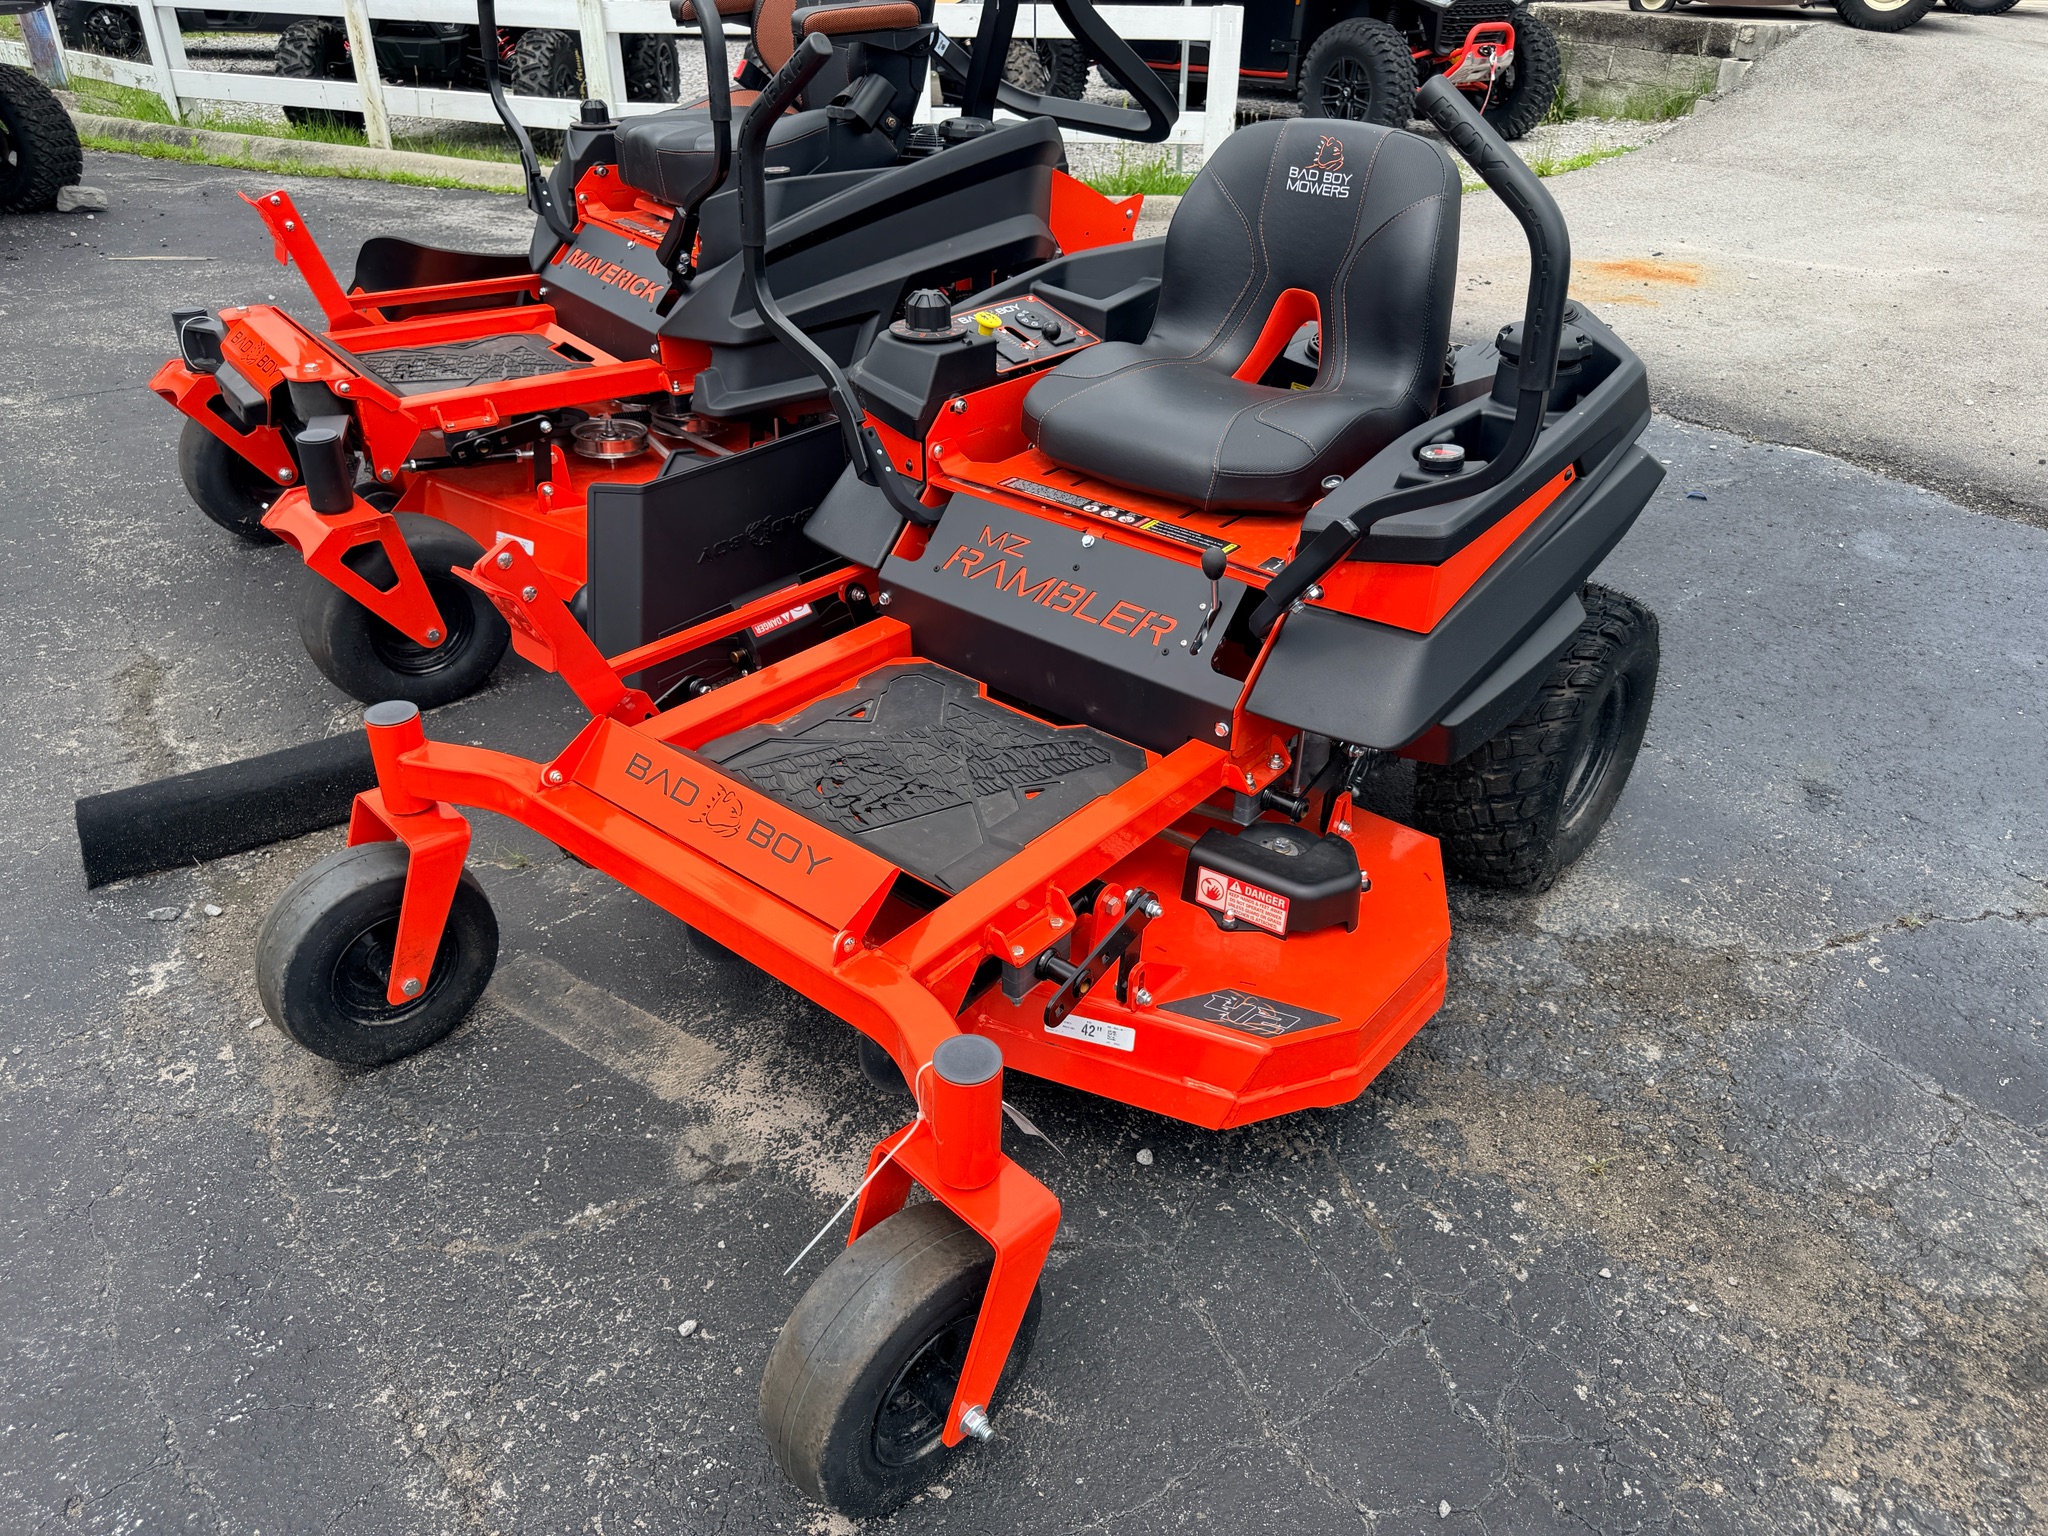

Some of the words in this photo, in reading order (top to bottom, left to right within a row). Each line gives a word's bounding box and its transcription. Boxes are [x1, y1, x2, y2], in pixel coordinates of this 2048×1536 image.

[1426, 95, 1510, 174] BOY
[1286, 177, 1351, 198] MOWERS
[1288, 166, 1319, 181] BAD
[1322, 171, 1353, 186] BOY
[565, 248, 665, 303] MAVERICK
[995, 303, 1020, 316] BOY
[230, 331, 253, 353] BAD
[256, 354, 279, 377] BOY
[978, 524, 1031, 558] MZ
[942, 544, 1178, 646] RAMBLER
[754, 616, 783, 634] DANGER
[624, 752, 699, 807] BAD
[746, 818, 833, 876] BOY
[1245, 886, 1285, 909] DANGER
[1246, 903, 1264, 913] OPERATE
[1228, 902, 1244, 911] UNLESS
[1245, 908, 1259, 917] GUARD
[1267, 916, 1282, 926] GRASS
[1081, 1023, 1102, 1038] 42"
